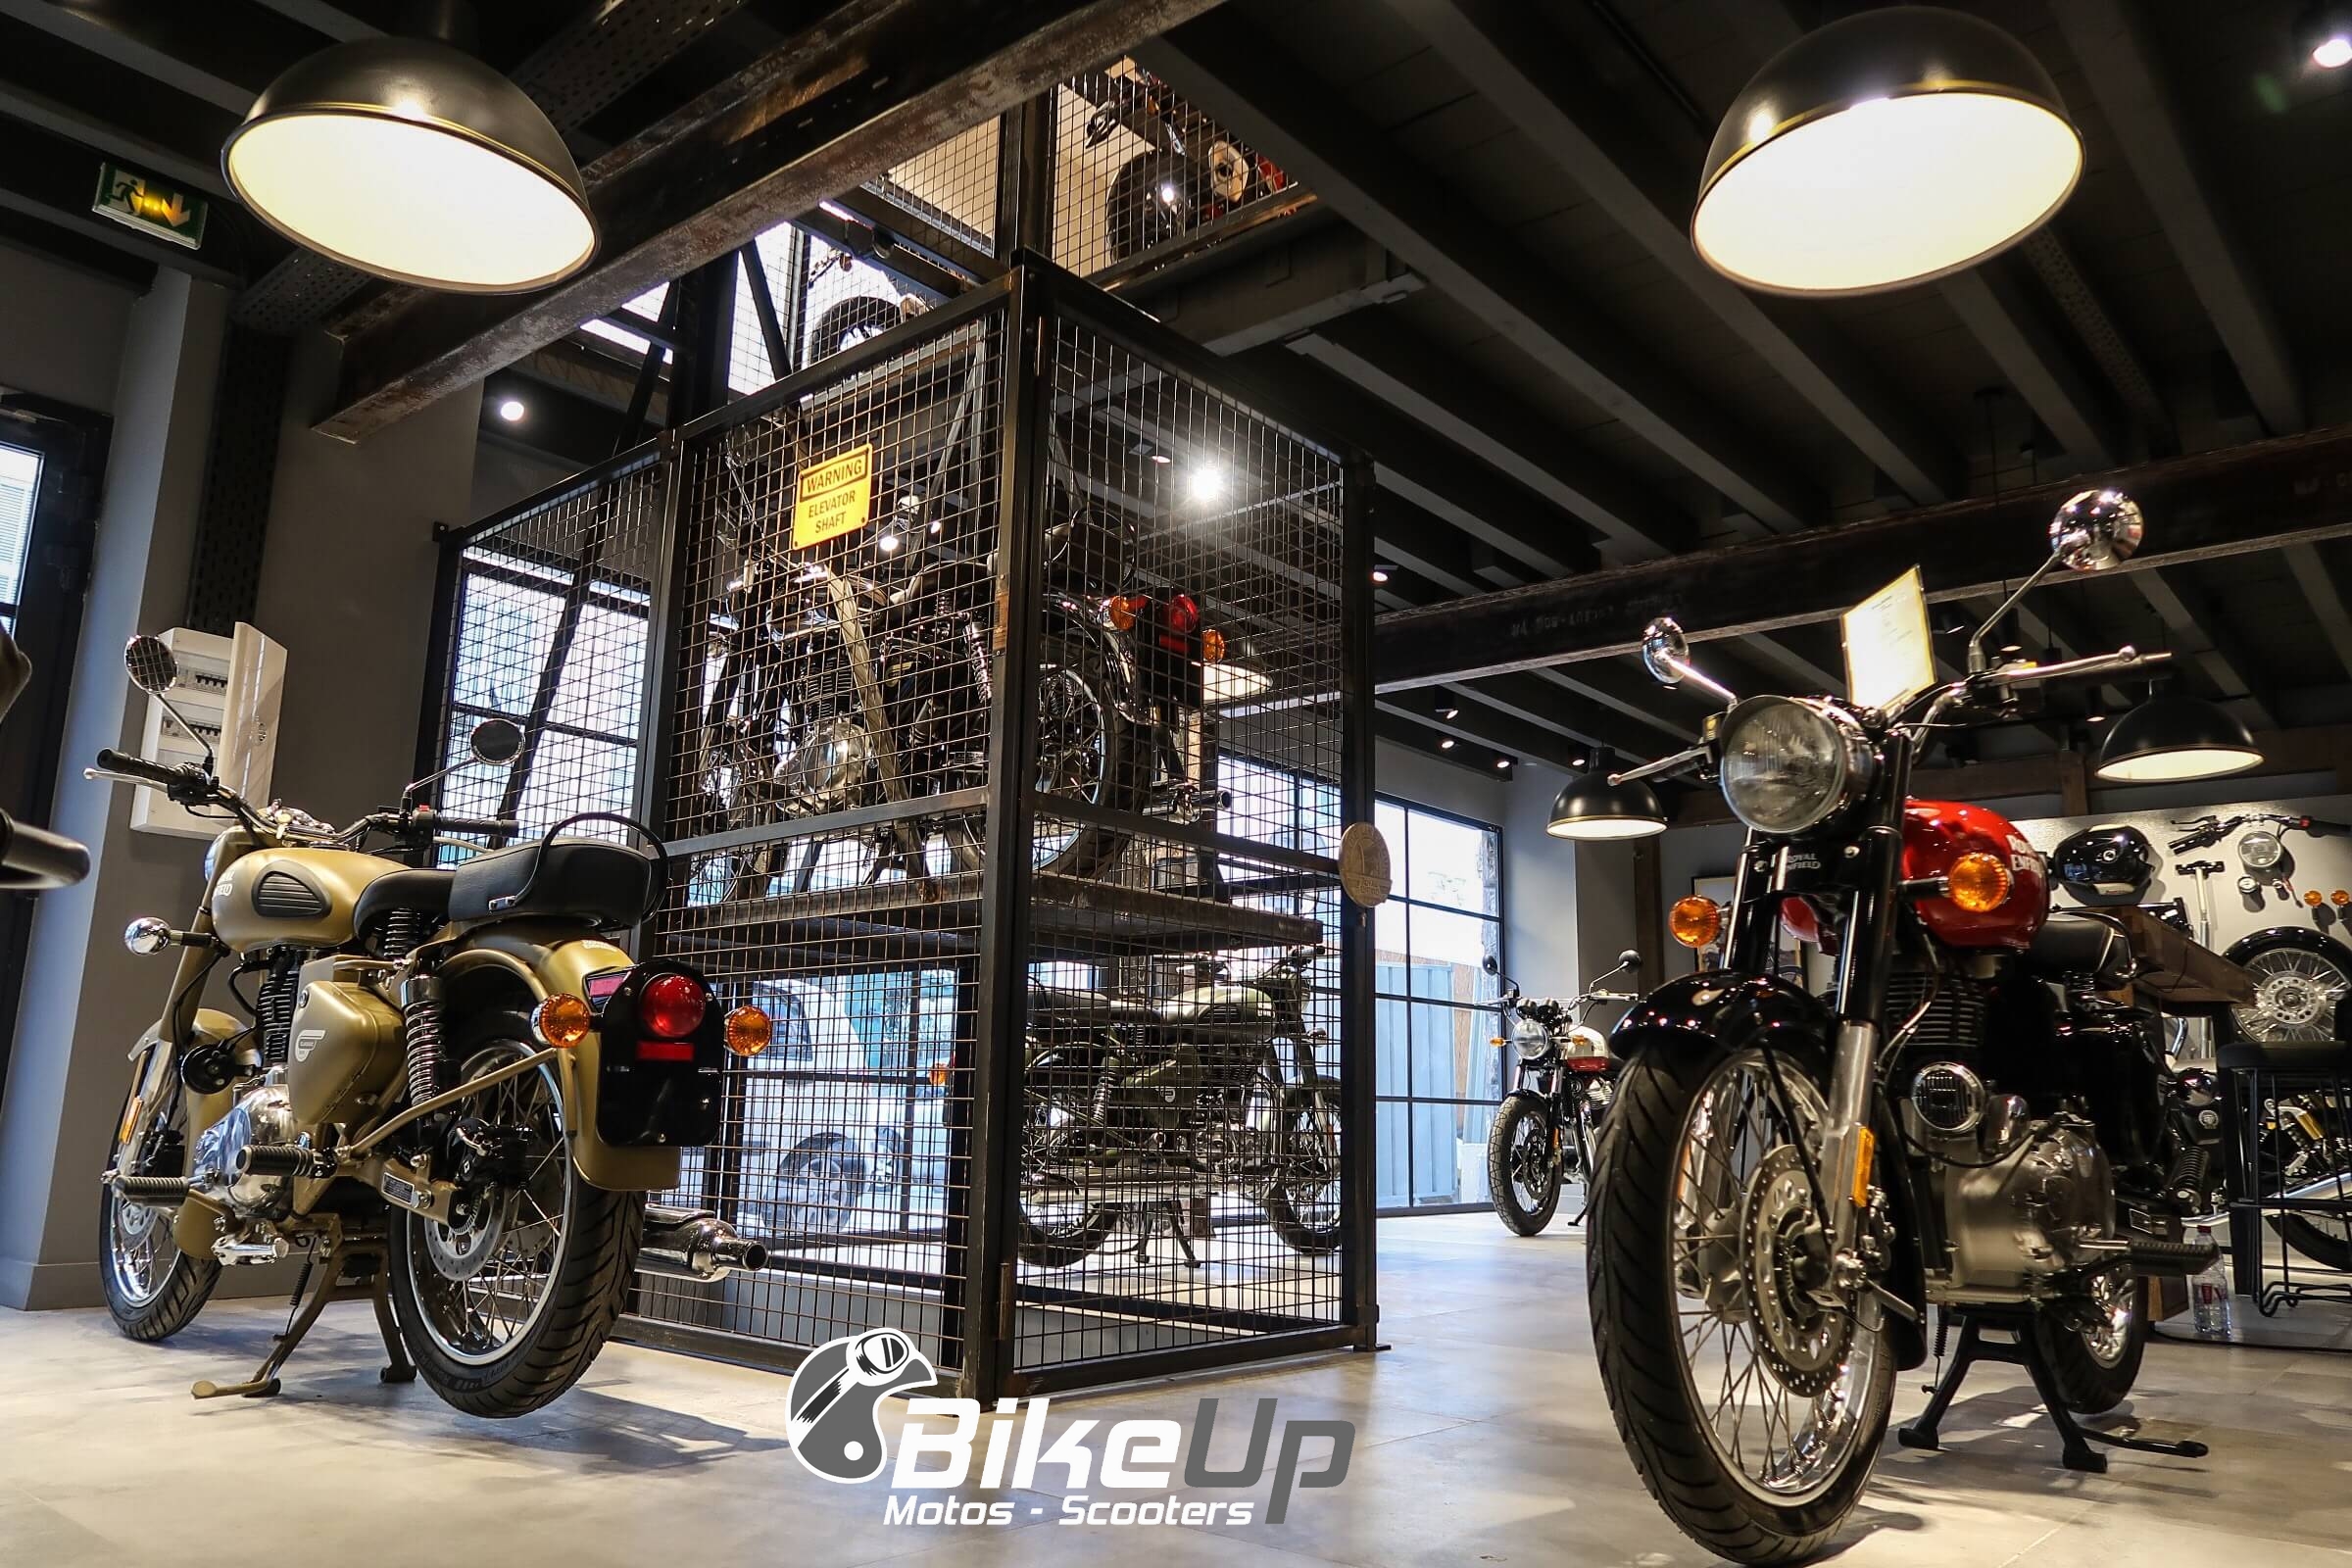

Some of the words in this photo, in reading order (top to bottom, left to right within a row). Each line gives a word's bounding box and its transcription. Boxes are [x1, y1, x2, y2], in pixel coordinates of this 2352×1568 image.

[807, 459, 862, 493] WARNING
[808, 490, 857, 518] ELEVATOR
[815, 511, 847, 534] SHAFT
[1787, 853, 1818, 863] OYAL
[1787, 860, 1822, 871] NFIELD
